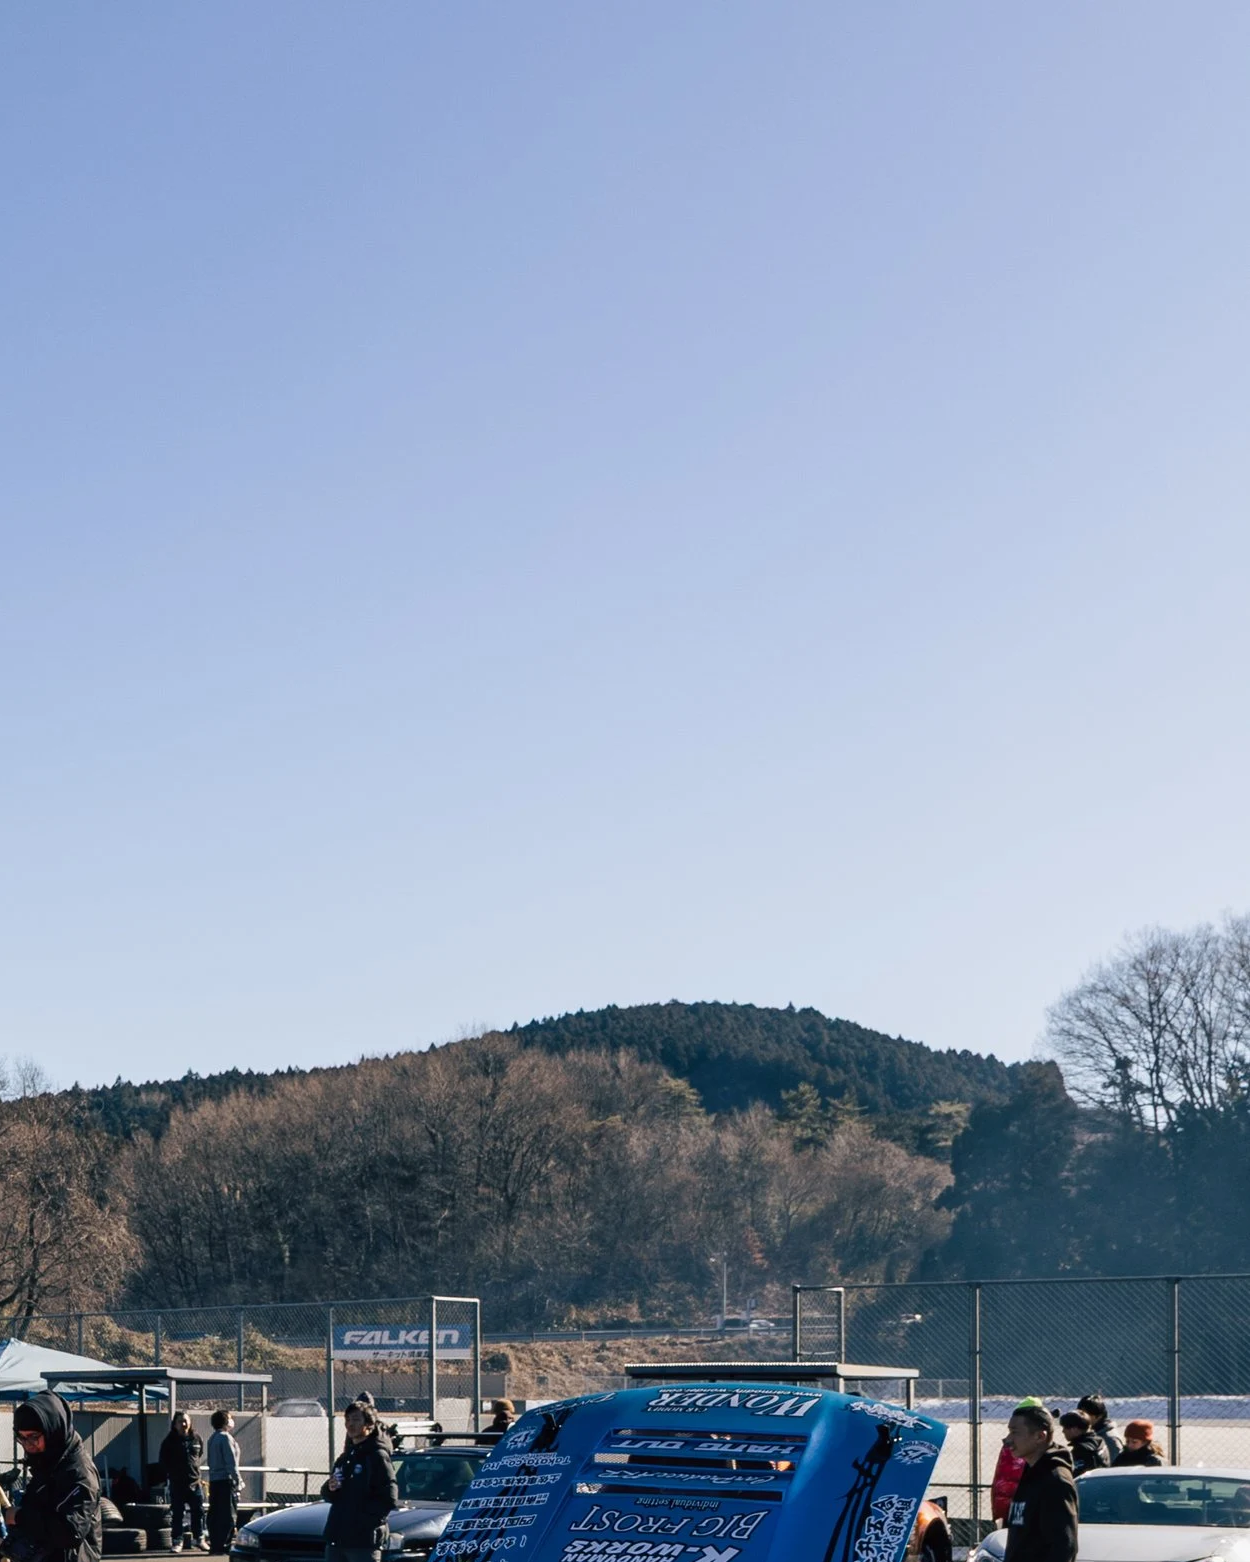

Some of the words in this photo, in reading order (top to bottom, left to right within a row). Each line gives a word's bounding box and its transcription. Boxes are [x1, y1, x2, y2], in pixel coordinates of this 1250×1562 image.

[647, 1392, 819, 1417] WONDER
[610, 1440, 685, 1450] OUT
[694, 1443, 795, 1454] HANG
[671, 1499, 719, 1510] individual
[569, 1505, 691, 1534] FROST
[692, 1510, 769, 1539] BIG
